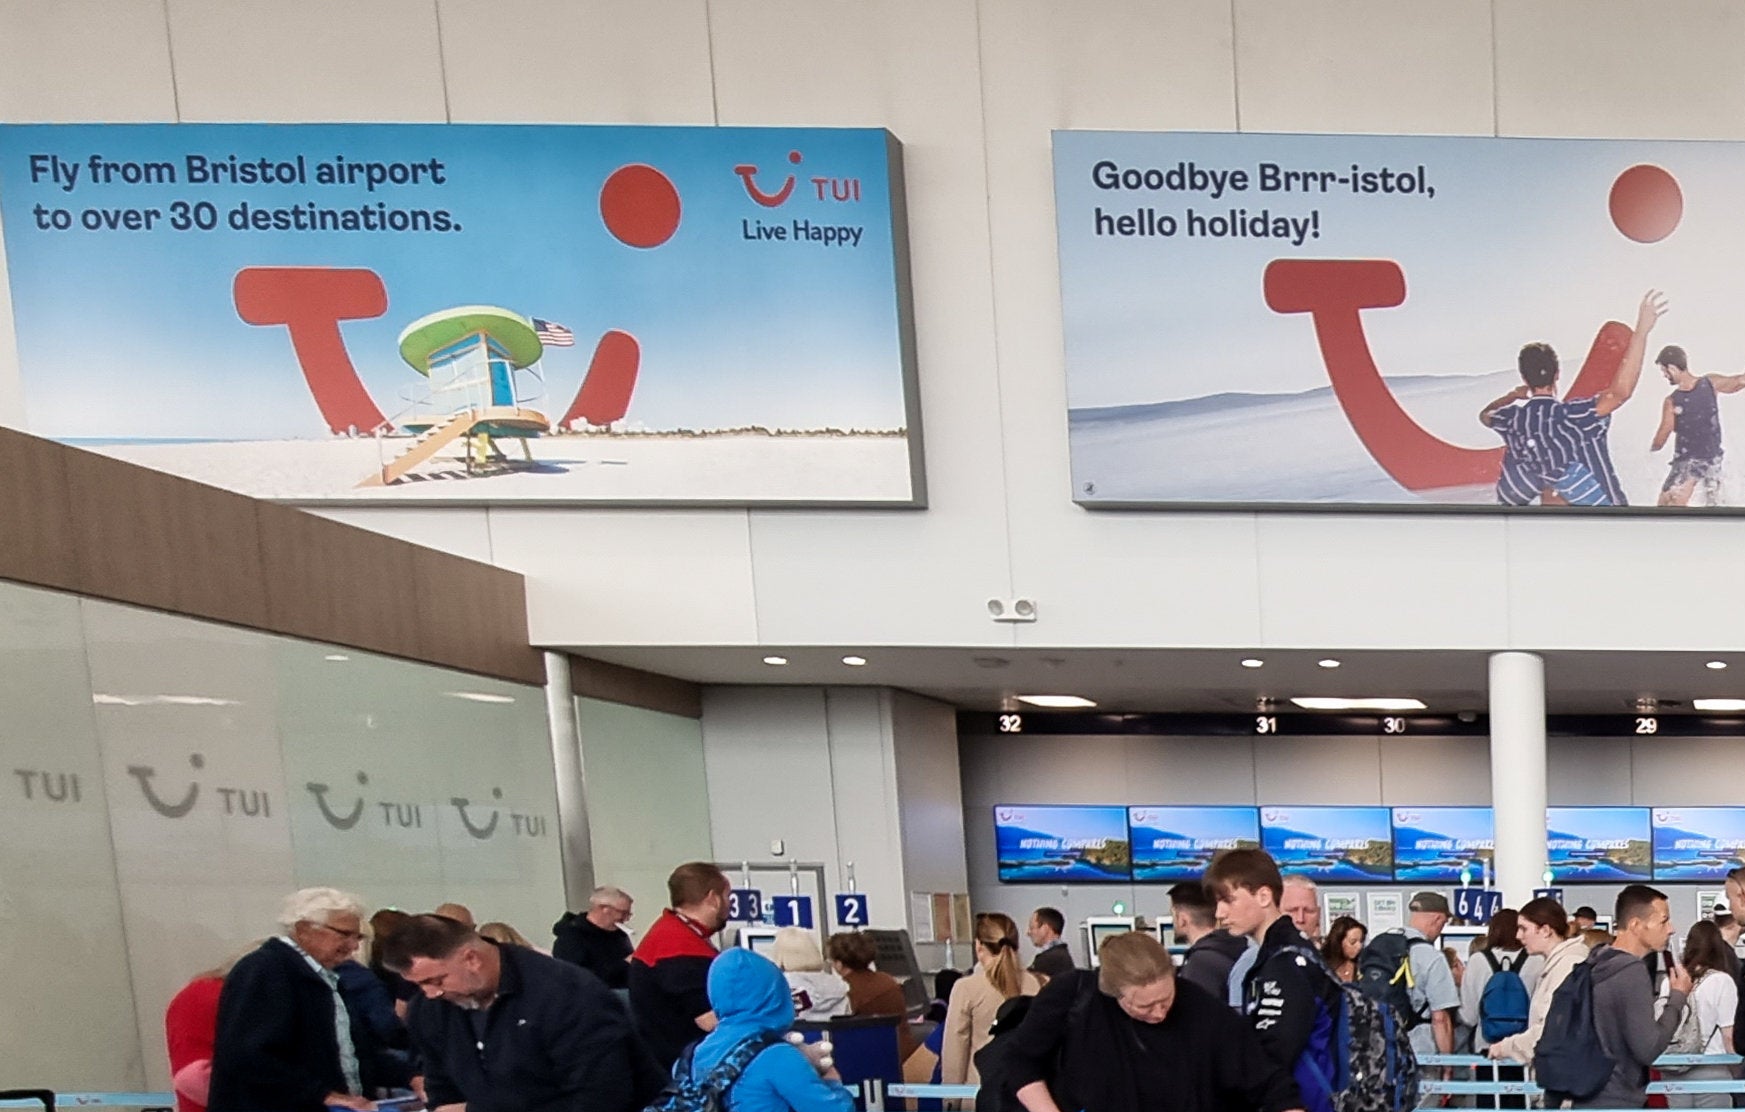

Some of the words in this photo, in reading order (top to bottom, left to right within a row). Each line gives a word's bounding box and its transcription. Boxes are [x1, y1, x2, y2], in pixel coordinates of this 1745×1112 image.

[29, 153, 81, 192] Fly
[88, 155, 175, 183] from
[186, 155, 305, 183] Bristol
[316, 155, 445, 191] airport
[1093, 161, 1248, 199] Goodbye
[1260, 164, 1434, 198] Brrr-istol,
[811, 179, 859, 201] TUI
[34, 203, 72, 232] to
[82, 210, 160, 230] over
[170, 202, 217, 230] 30
[229, 202, 461, 231] destinations.
[1095, 208, 1176, 236] hello
[1187, 209, 1319, 246] holiday!
[743, 219, 786, 240] Live
[793, 220, 863, 247] Happy
[1000, 715, 1021, 732] 32
[1257, 717, 1275, 733] 31
[1384, 718, 1404, 733] 30
[1636, 718, 1657, 733] 29
[13, 769, 81, 802] TUI
[216, 788, 270, 817] TUI
[378, 802, 421, 828] TUI
[510, 814, 546, 837] TUI
[748, 894, 758, 918] 3
[788, 901, 799, 925] 1
[843, 899, 861, 923] 2
[1459, 892, 1468, 915] 6
[1474, 896, 1483, 920] 4
